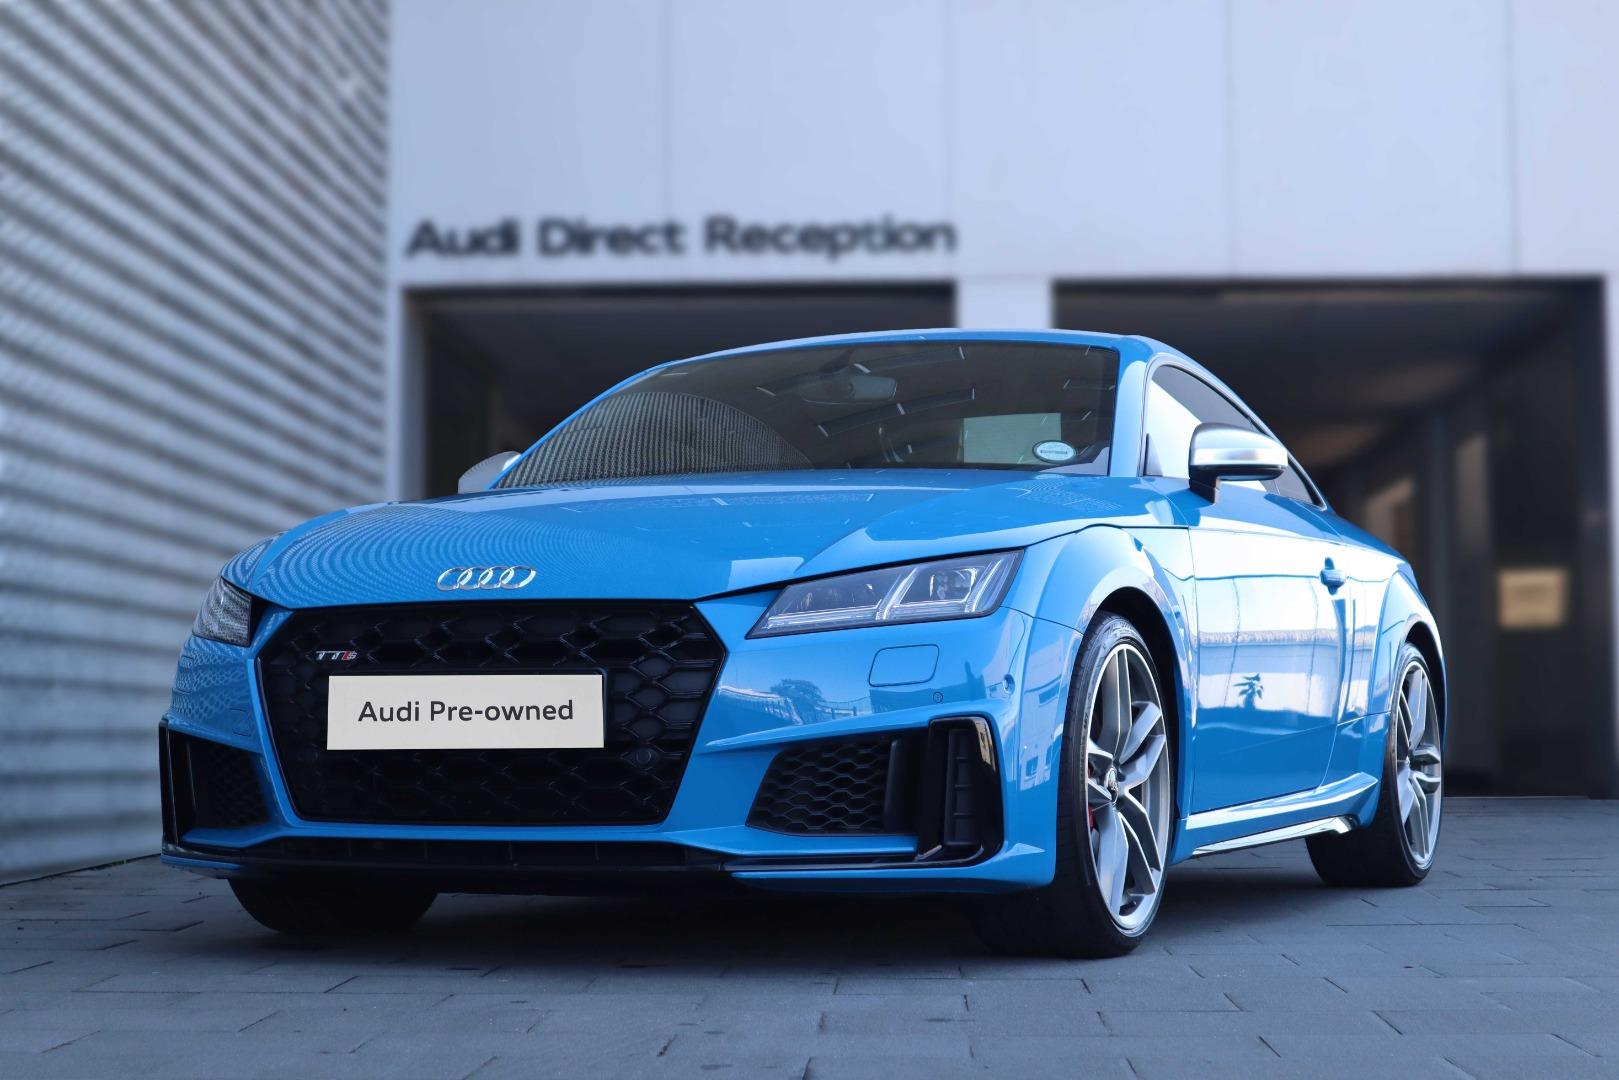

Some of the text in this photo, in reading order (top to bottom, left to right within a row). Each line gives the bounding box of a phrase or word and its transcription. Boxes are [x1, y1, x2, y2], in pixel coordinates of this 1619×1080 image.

[406, 214, 957, 261] Audi Direct Reception
[358, 700, 574, 722] Audi Pre-owned
